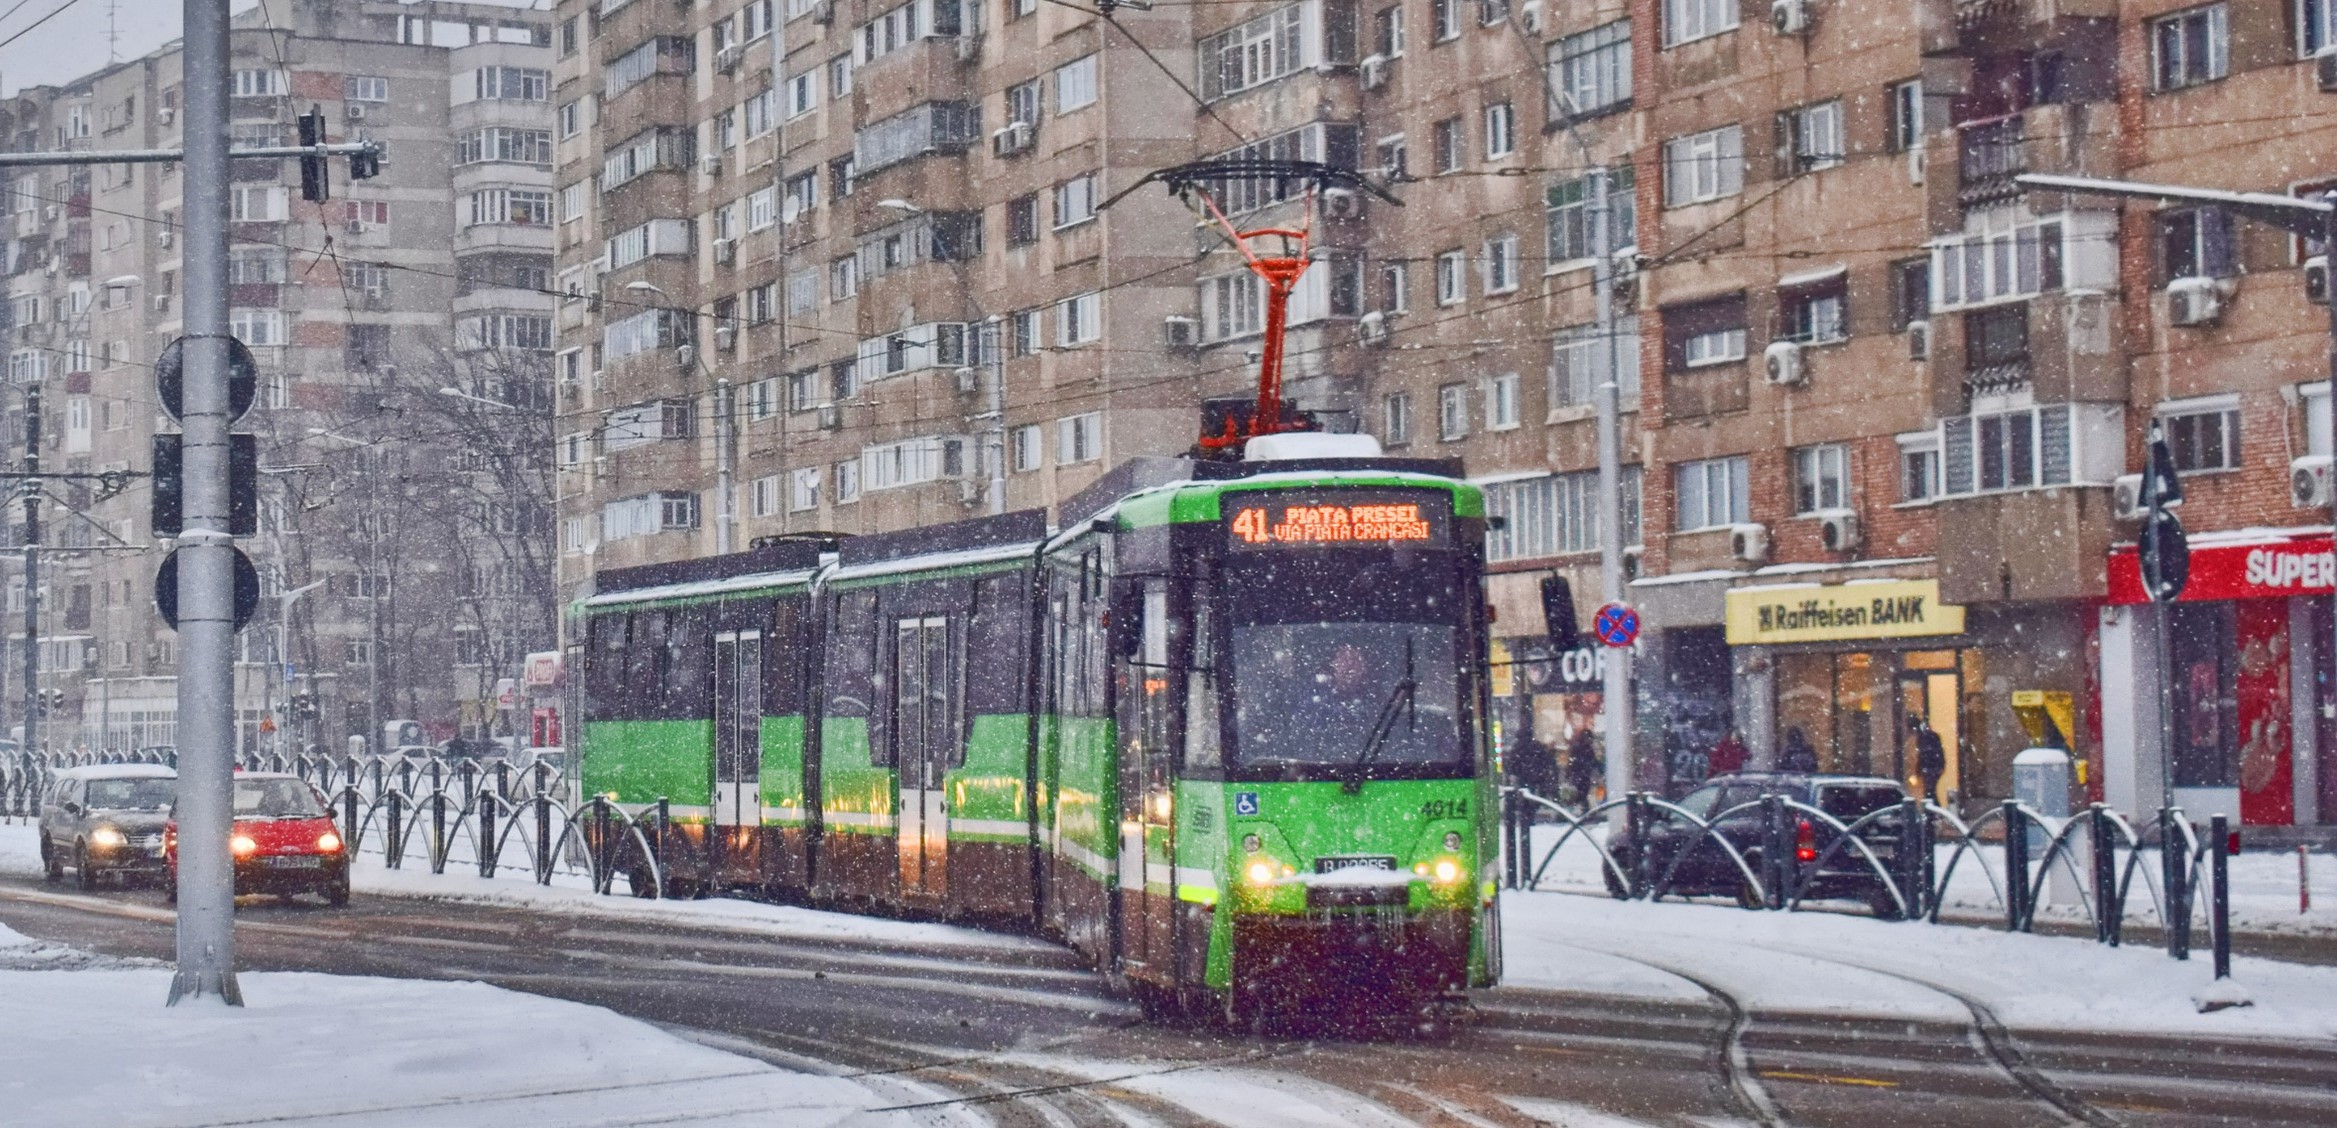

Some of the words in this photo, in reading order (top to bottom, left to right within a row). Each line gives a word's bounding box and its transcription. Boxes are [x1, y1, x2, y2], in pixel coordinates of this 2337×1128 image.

[1233, 508, 1269, 543] 41
[1286, 506, 1348, 524] PIATA
[1352, 504, 1419, 523] PRESEI
[1274, 524, 1303, 541] VIA
[1304, 523, 1350, 541] PIATA
[2245, 549, 2335, 588] SUPER
[1775, 599, 1866, 630] Raiffeisen
[1871, 595, 1925, 625] BANK
